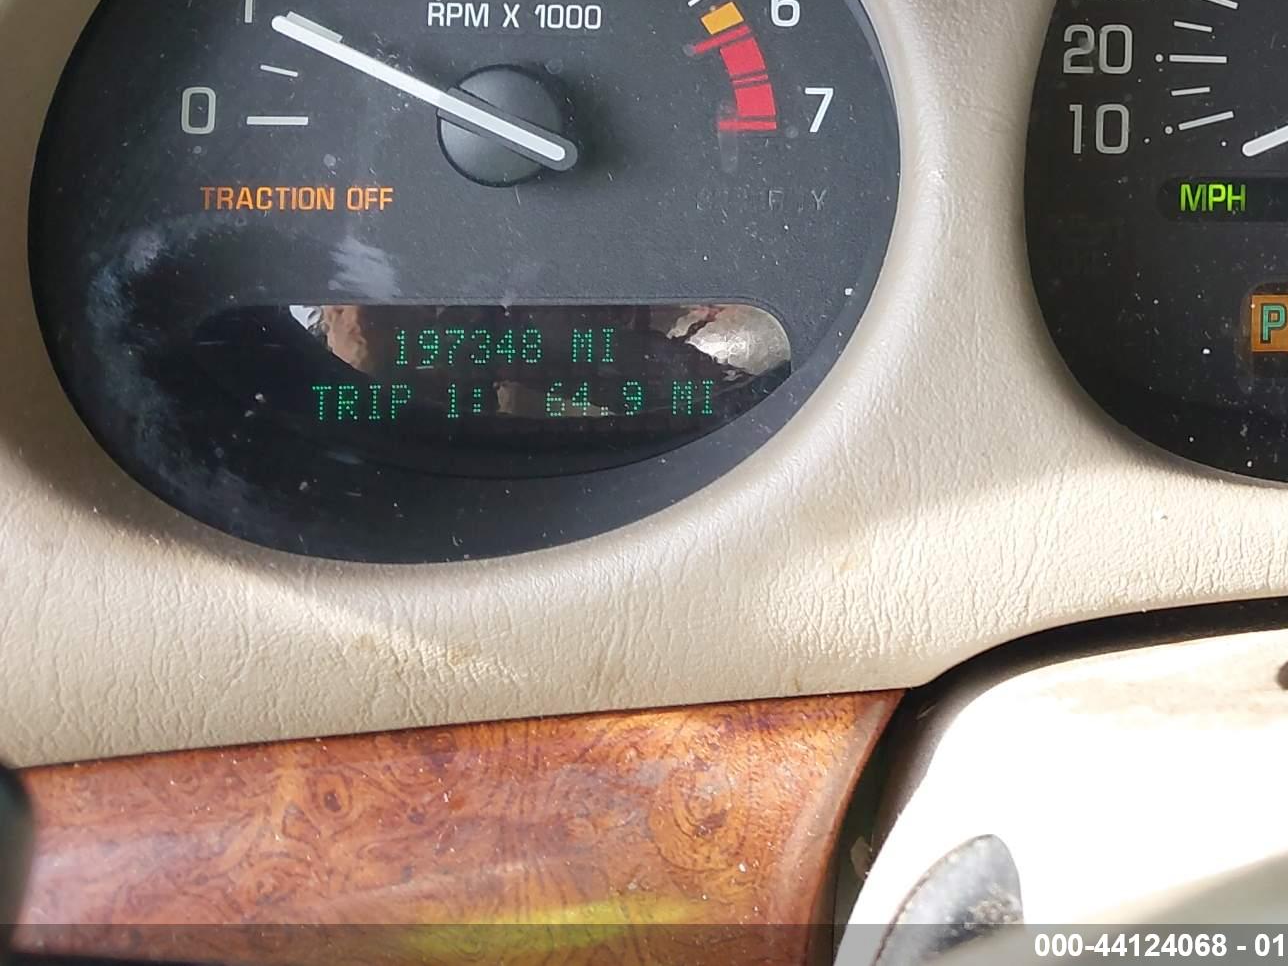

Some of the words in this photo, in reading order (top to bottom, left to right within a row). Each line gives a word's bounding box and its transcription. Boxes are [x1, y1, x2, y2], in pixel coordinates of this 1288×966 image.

[427, 2, 489, 28] RPM
[502, 3, 520, 28] X
[534, 4, 602, 30] 1000
[1063, 24, 1133, 75] 20
[181, 86, 217, 135] 0
[804, 87, 834, 133] 7
[1069, 103, 1130, 154] 10
[201, 186, 335, 210] TRACTION
[346, 187, 393, 211] OFF
[1180, 184, 1245, 211] MPH
[1260, 304, 1286, 341] P
[395, 329, 543, 366] 197348
[572, 328, 615, 363] MI
[311, 384, 412, 421] TRIP
[544, 380, 643, 418] 64.9
[671, 378, 715, 416] MI
